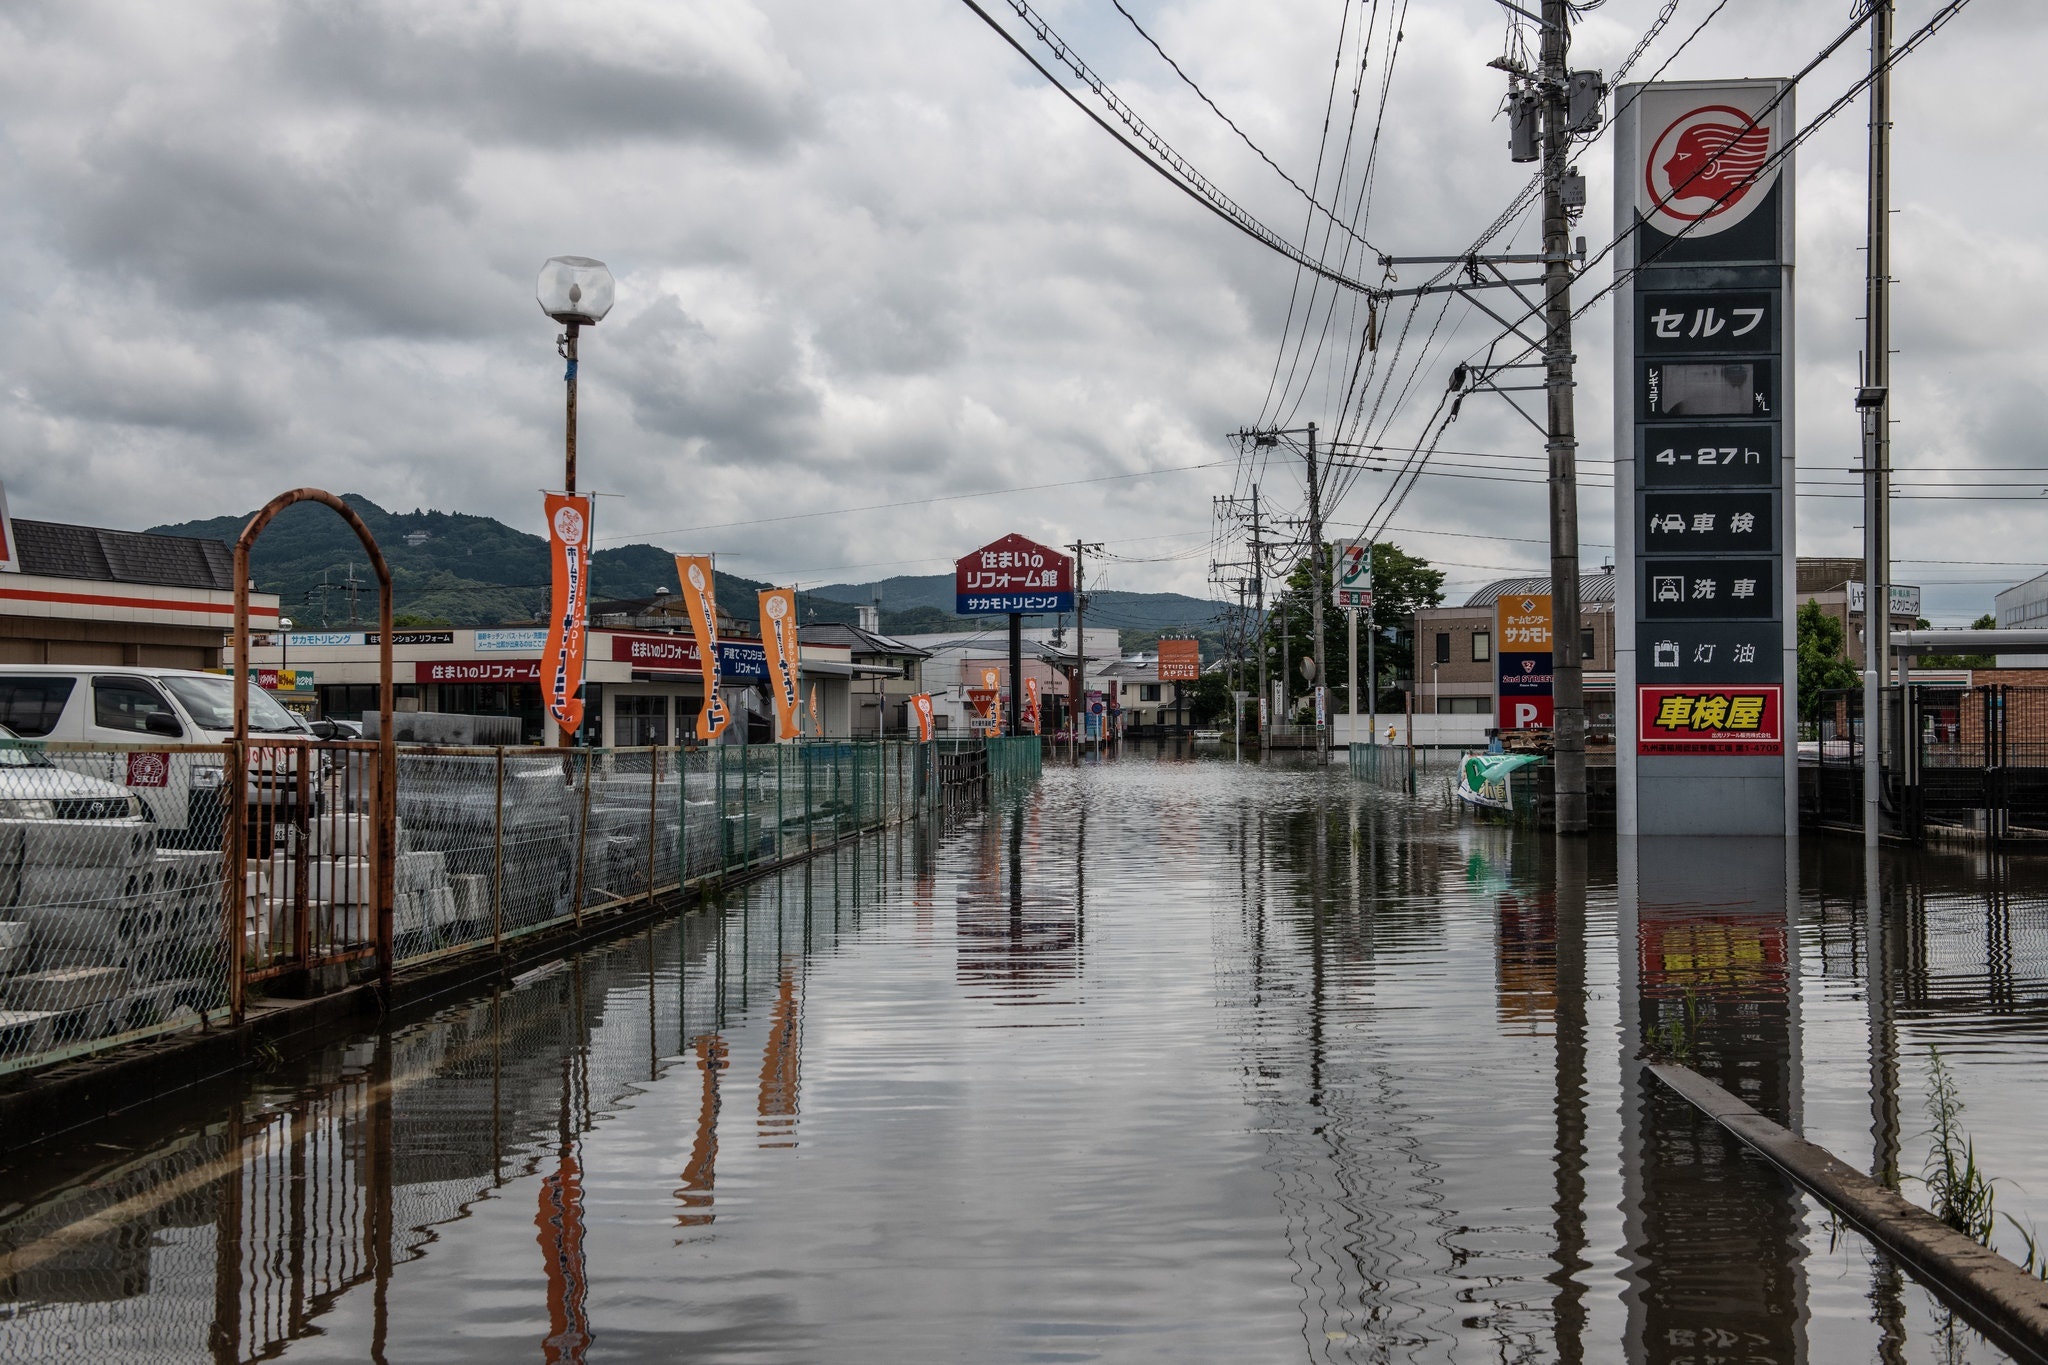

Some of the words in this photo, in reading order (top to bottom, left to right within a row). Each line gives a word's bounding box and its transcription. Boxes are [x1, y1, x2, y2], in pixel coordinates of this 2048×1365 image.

[1651, 307, 1764, 338] セルフ
[1648, 368, 1659, 412] レギュラー
[1691, 512, 1755, 534] 車検
[981, 551, 1044, 569] 住まいの
[967, 569, 1058, 588] リフォーム館
[1692, 578, 1756, 599] 洗車
[968, 596, 1058, 610] サカモトリビング
[1507, 615, 1550, 625] ホームセンター
[291, 634, 351, 645] サカモトリビング
[419, 631, 450, 642] リフォーム
[1505, 627, 1552, 643] サカモト
[1694, 644, 1756, 663] 灯油
[431, 664, 541, 679] 住まいのリフォーム
[735, 662, 760, 674] リフォーム
[1072, 668, 1078, 677] P
[1502, 675, 1521, 683] 2nd
[1515, 703, 1538, 729] P
[1655, 695, 1765, 730] 車検屋
